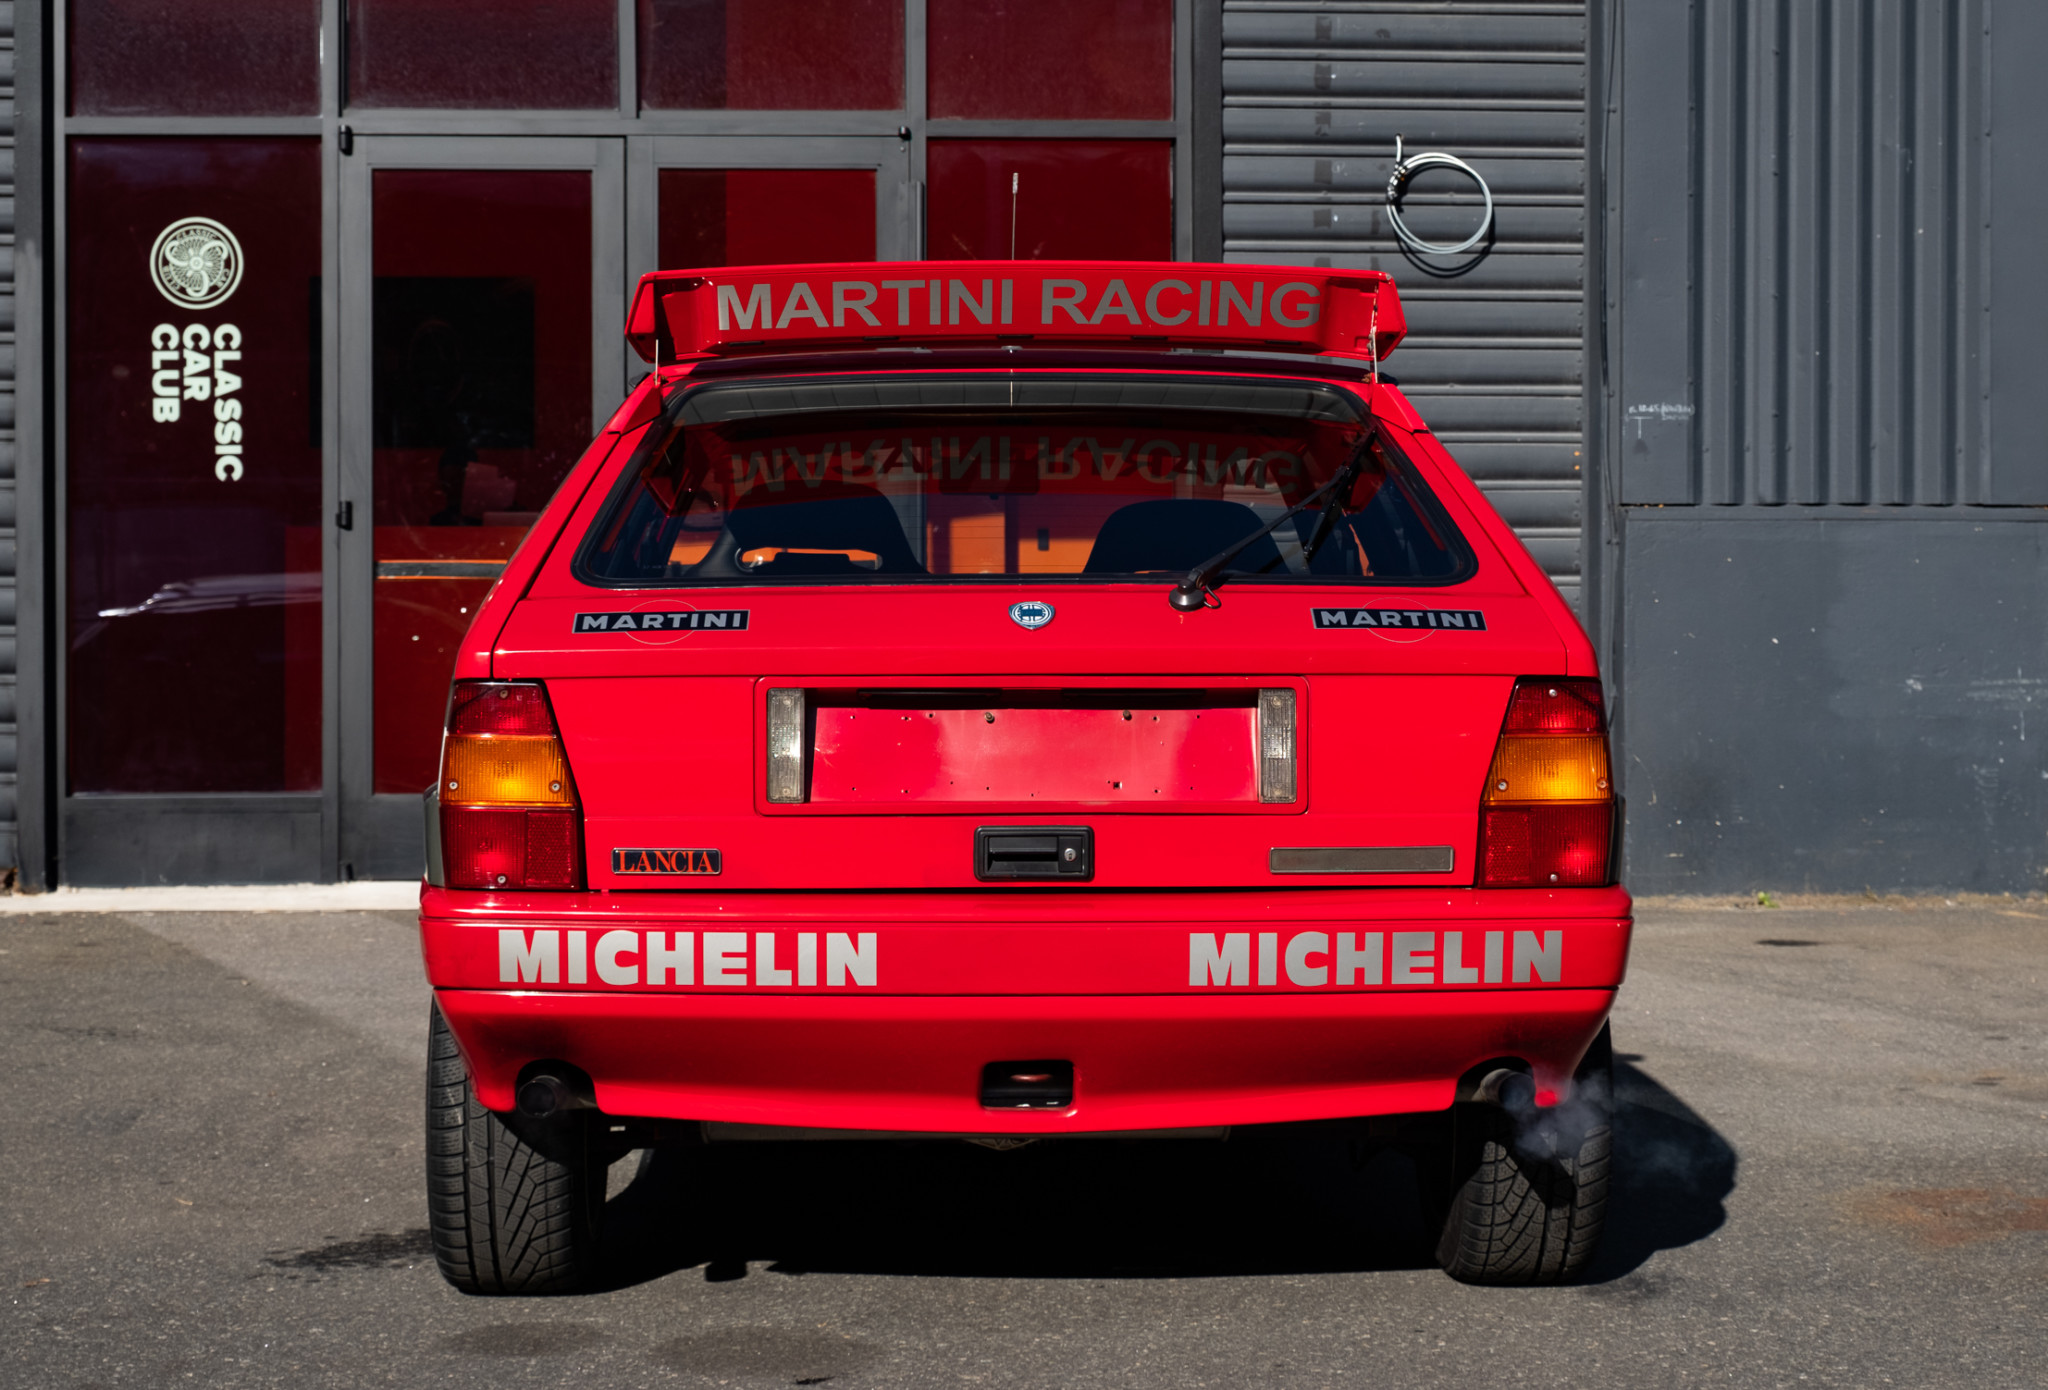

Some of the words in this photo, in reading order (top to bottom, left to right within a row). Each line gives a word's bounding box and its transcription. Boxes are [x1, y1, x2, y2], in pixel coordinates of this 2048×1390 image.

[717, 279, 1014, 331] MARTINI
[1041, 279, 1323, 329] RACING
[151, 323, 181, 424] CLUB
[182, 323, 212, 402] CAR
[213, 323, 244, 483] CLASSIC
[581, 613, 742, 631] MARTINI
[1319, 610, 1480, 628] MARTINI
[618, 850, 716, 873] LANCIA
[497, 928, 879, 988] MICHELIN
[1188, 930, 1563, 987] MICHELIN
